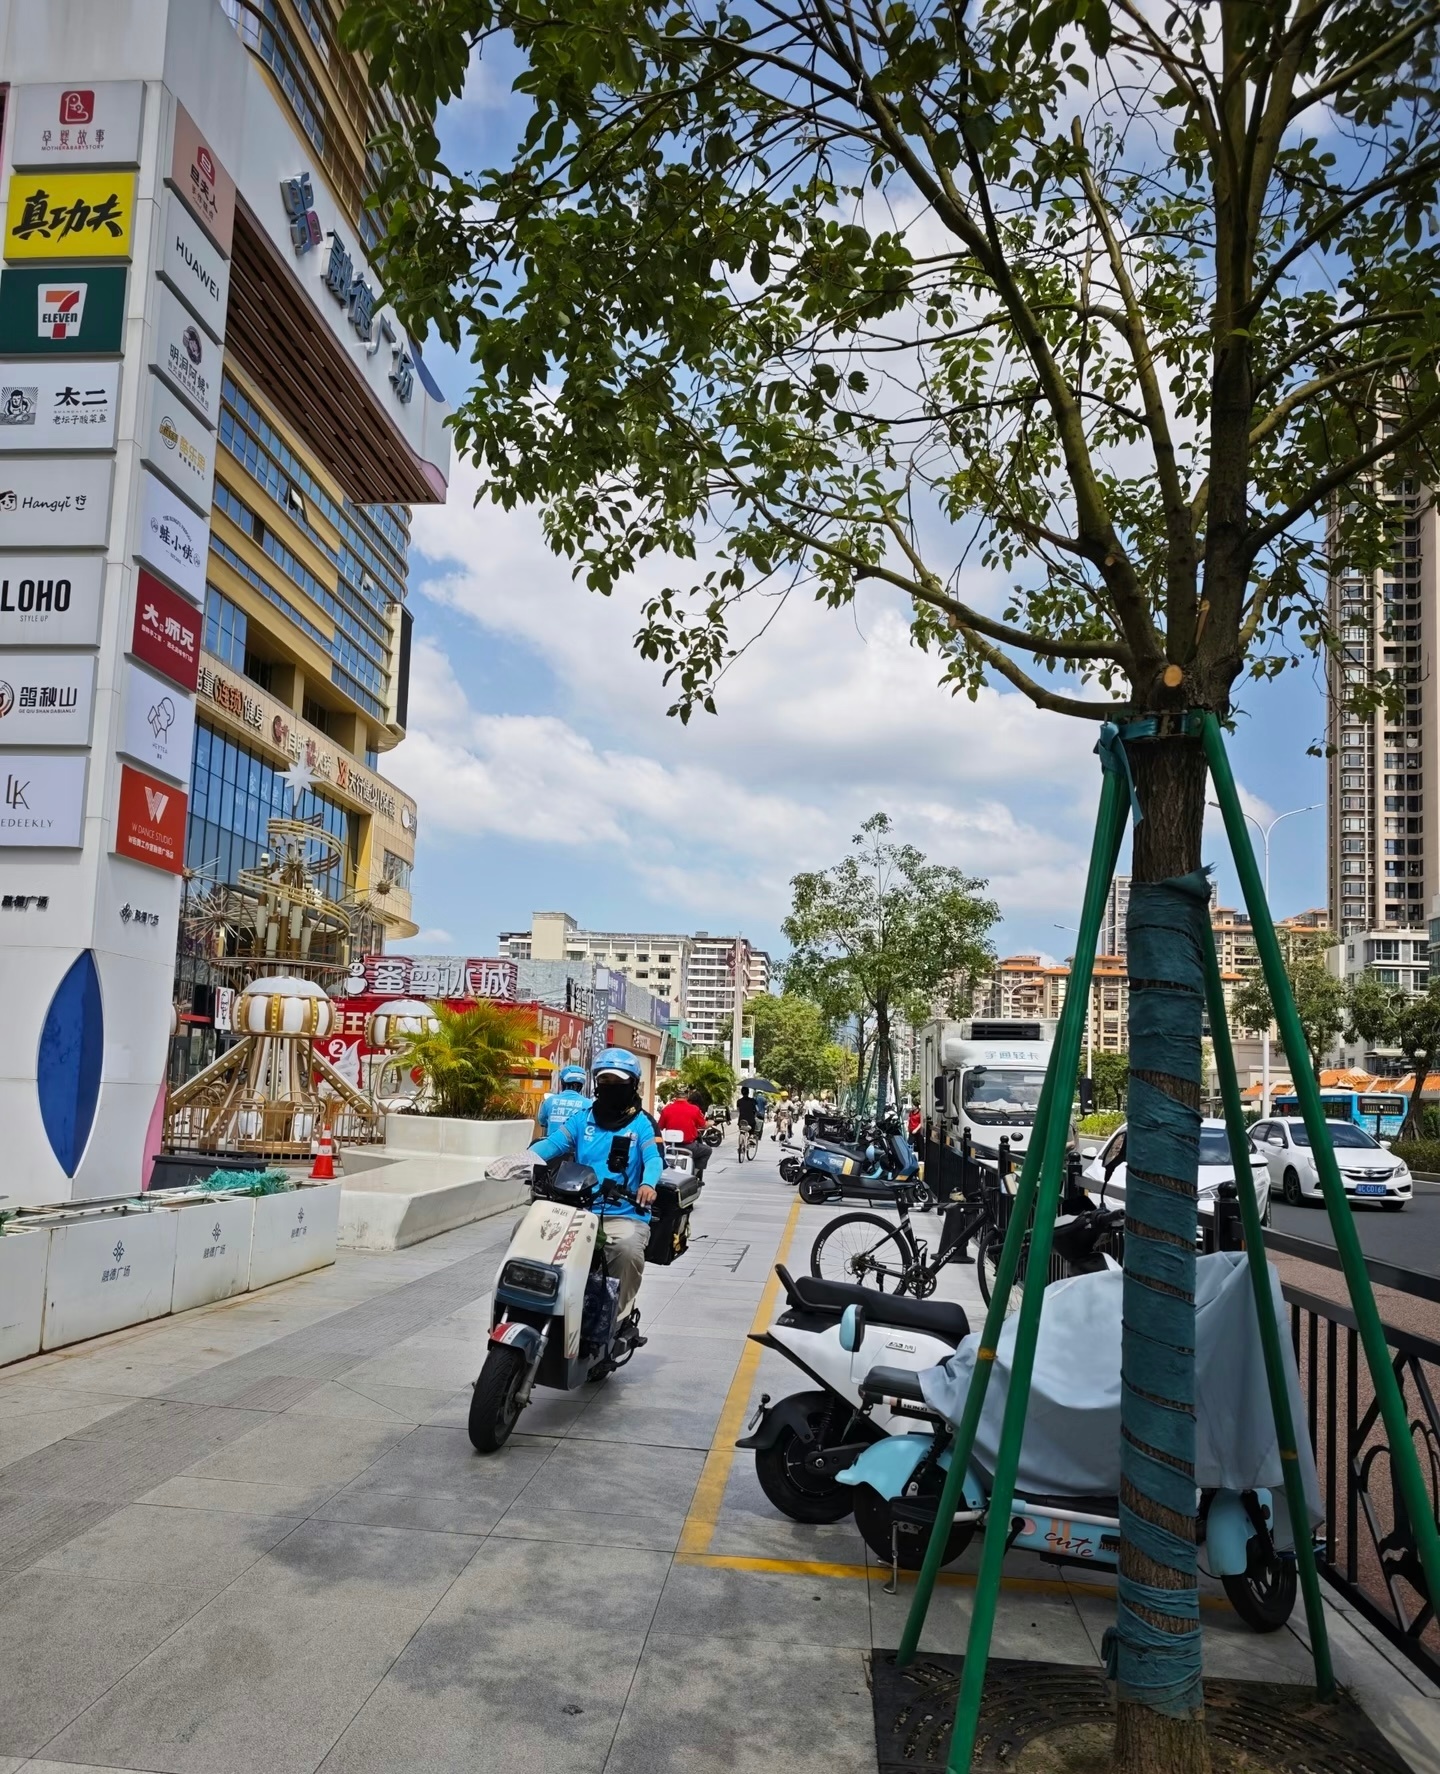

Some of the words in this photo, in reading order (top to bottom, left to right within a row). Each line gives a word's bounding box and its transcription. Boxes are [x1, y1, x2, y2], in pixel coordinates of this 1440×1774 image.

[42, 129, 105, 146] 孕婴故事
[12, 189, 123, 243] 真功夫
[176, 236, 220, 302] HUAWEI
[169, 343, 206, 396] 明洞阿姨
[53, 386, 108, 407] 太二
[52, 413, 107, 425] 老坛子酸菜鱼
[22, 495, 71, 511] Hangyi
[159, 524, 194, 565] 蛙小侠
[1, 579, 71, 612] LOHO
[19, 687, 77, 707] 鸽秋山
[138, 824, 155, 839] DANCE
[155, 831, 173, 846] STUDIO
[371, 960, 511, 998] 蜜雪冰城
[938, 1246, 957, 1266] JAVA
[101, 1265, 131, 1283] 融德广场
